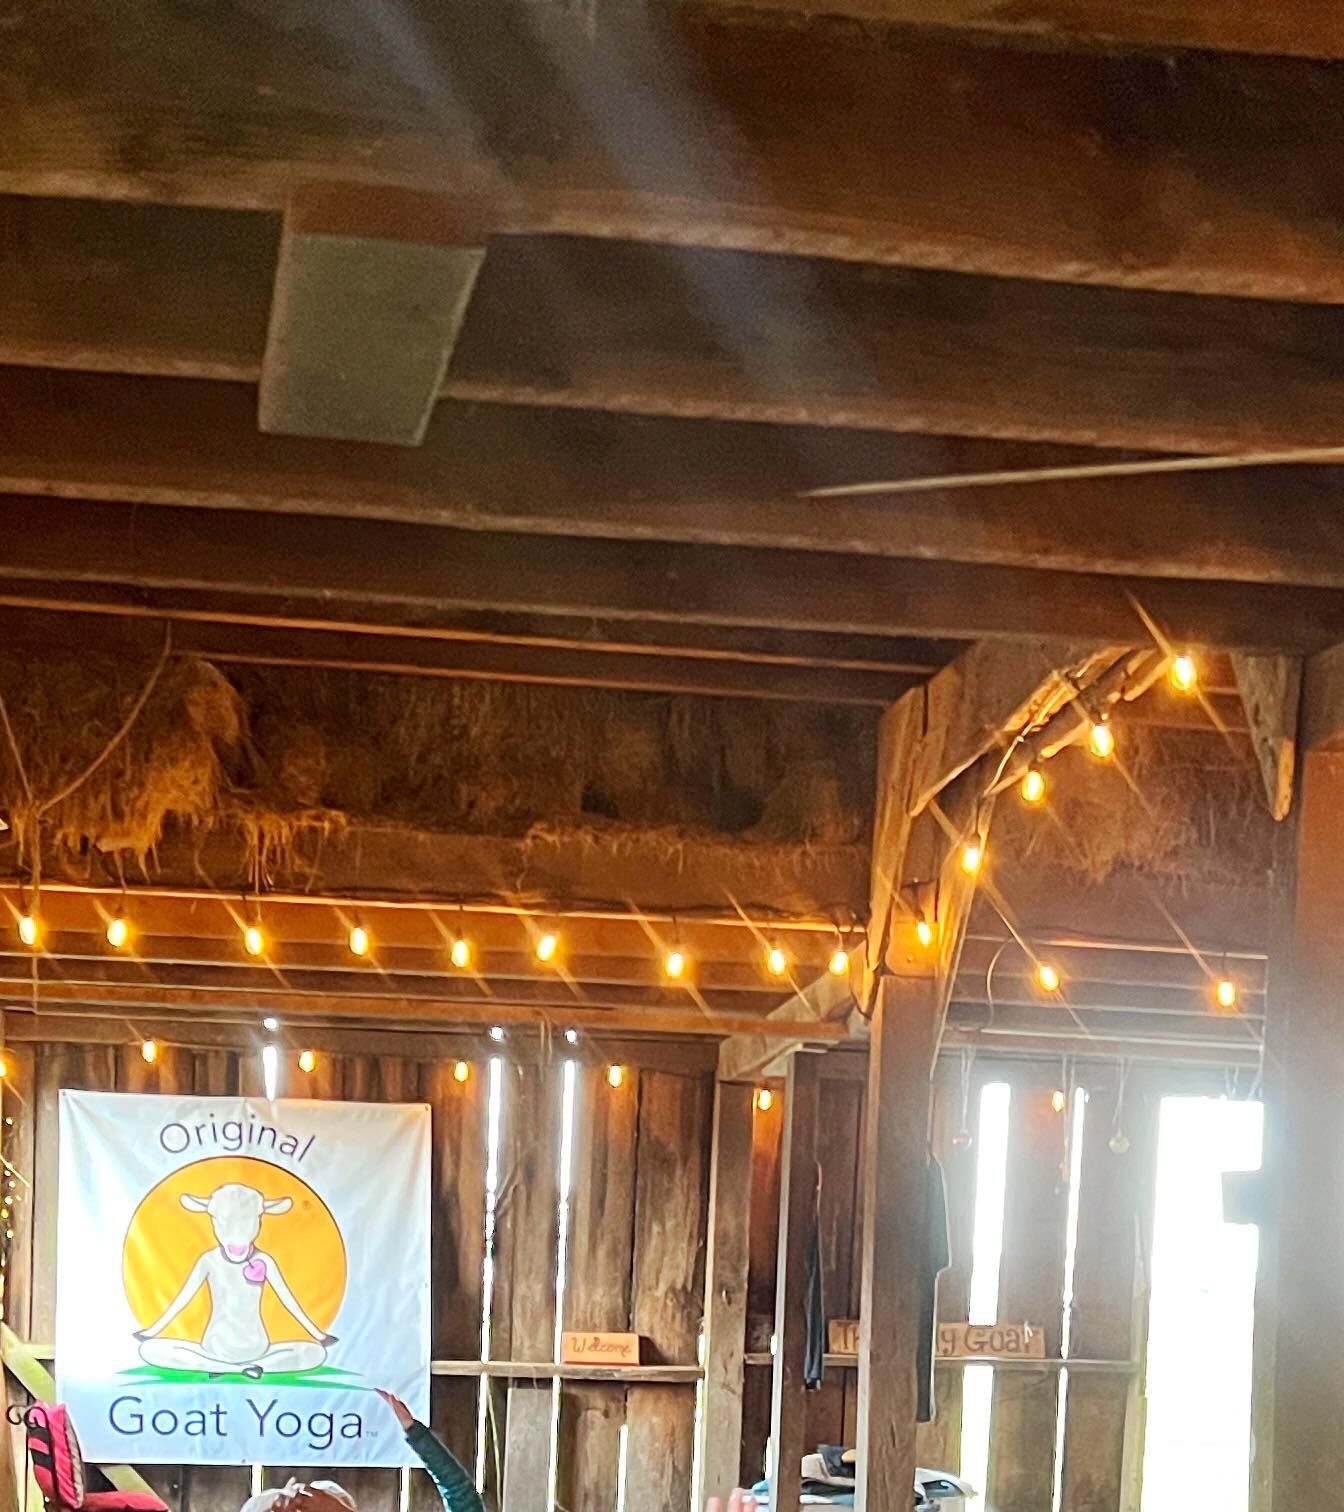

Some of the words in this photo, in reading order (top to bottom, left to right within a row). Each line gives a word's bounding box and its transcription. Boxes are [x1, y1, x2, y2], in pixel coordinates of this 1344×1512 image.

[159, 1112, 316, 1163] Original
[108, 1395, 228, 1438] Goat
[245, 1398, 363, 1450] Yoga
